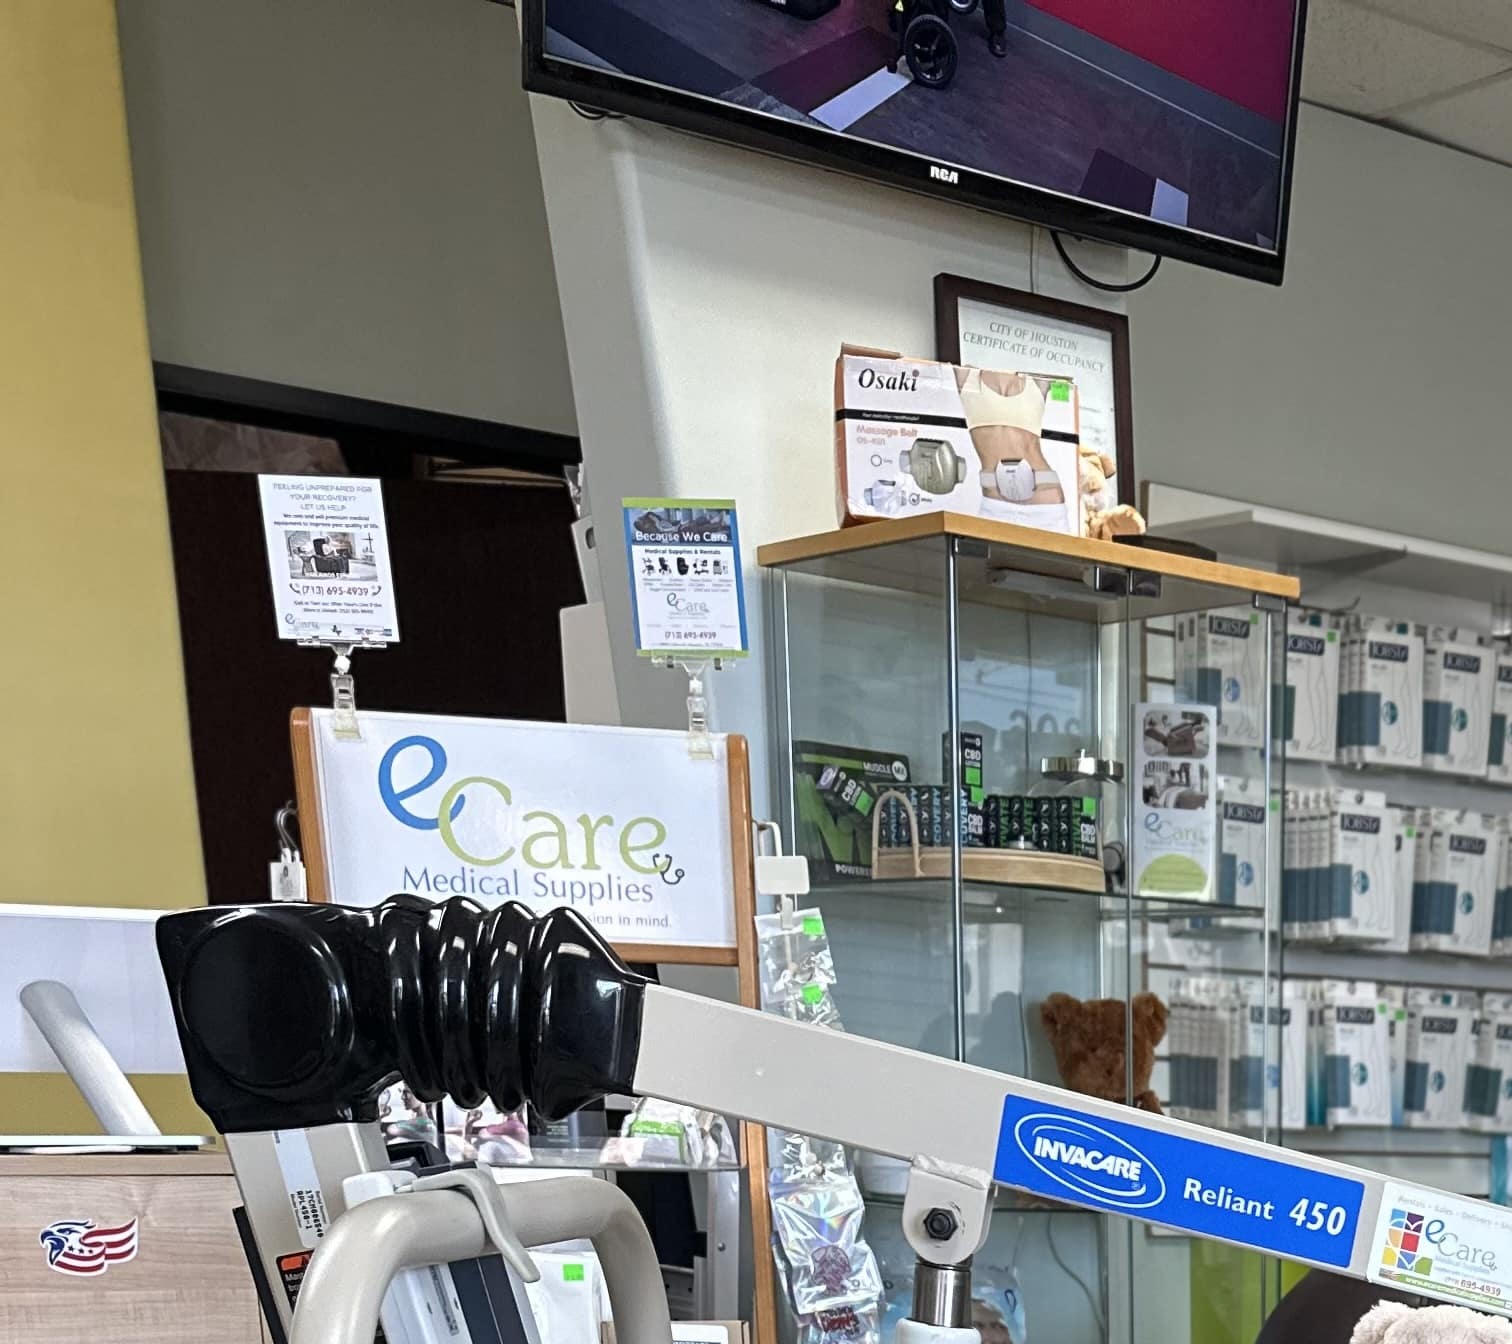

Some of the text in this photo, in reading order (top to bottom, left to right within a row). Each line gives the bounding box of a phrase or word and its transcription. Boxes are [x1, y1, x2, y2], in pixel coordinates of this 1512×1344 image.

[930, 165, 959, 184] RCA
[989, 321, 1078, 350] CITY OF HOUSTON
[962, 331, 1106, 372] CERTIFICATE OF OCCUPANCY
[858, 368, 920, 392] Osaki
[856, 424, 918, 438] Massage Belt
[636, 531, 728, 543] Because We Care
[302, 584, 369, 597] (713) 695-4939
[666, 592, 707, 613] eCare
[1210, 615, 1250, 638] JOBST
[1369, 640, 1408, 662] JOBST
[1444, 652, 1480, 673] JOBST
[965, 748, 981, 761] CBD
[863, 762, 891, 775] MUSCLE
[841, 778, 857, 802] CBD
[378, 735, 667, 874] eCare
[968, 813, 983, 826] CBD
[1081, 823, 1096, 834] CBD
[1341, 812, 1380, 834] JOBST
[1450, 834, 1486, 855] JOBST
[402, 866, 653, 903] Medical Supplies
[618, 913, 632, 926] in
[635, 912, 673, 928] mind.
[1336, 1006, 1375, 1024] JOBST
[1033, 1135, 1142, 1182] INVACARE
[1182, 1176, 1347, 1237] Reliant 450
[1425, 1219, 1497, 1267] eCare
[1460, 1279, 1502, 1297] 695-4939
